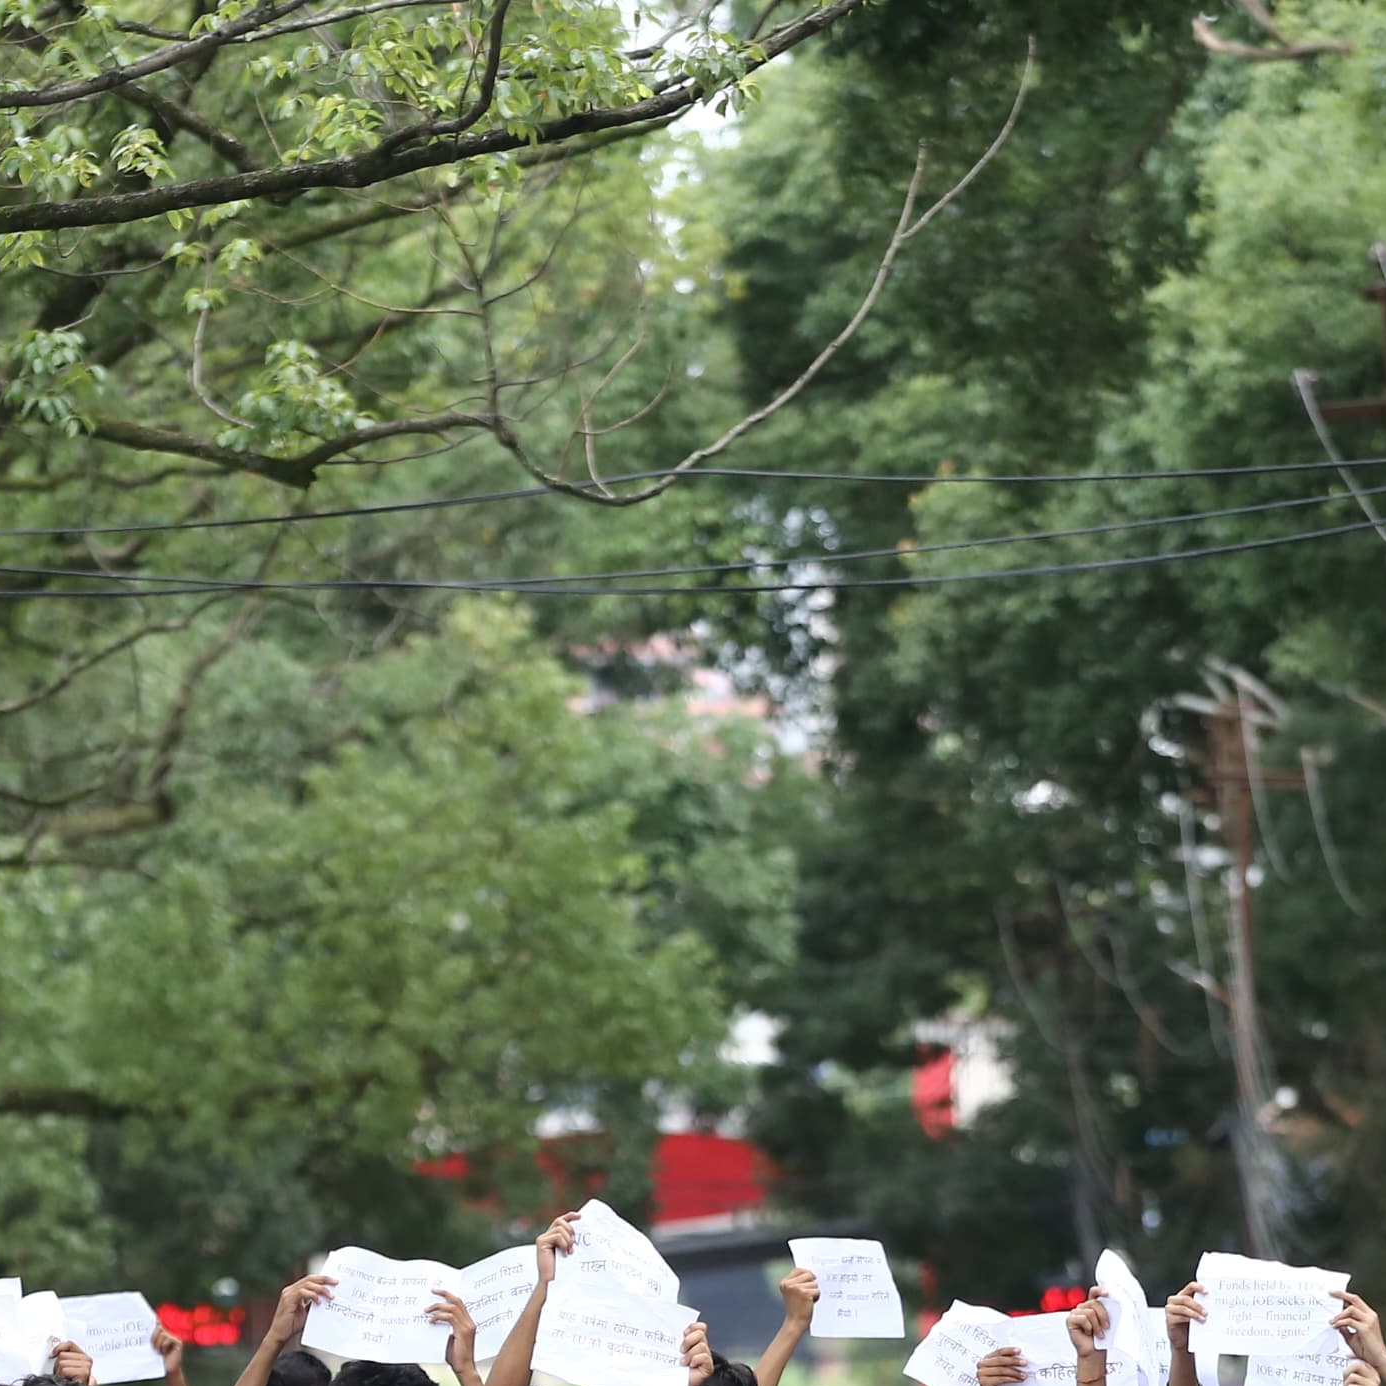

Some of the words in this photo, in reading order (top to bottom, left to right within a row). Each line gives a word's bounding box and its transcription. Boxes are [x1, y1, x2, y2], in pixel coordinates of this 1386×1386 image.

[1218, 1279, 1252, 1291] Funds
[1253, 1280, 1272, 1291] held
[1252, 1296, 1273, 1306] IOE
[1276, 1296, 1306, 1306] seeks
